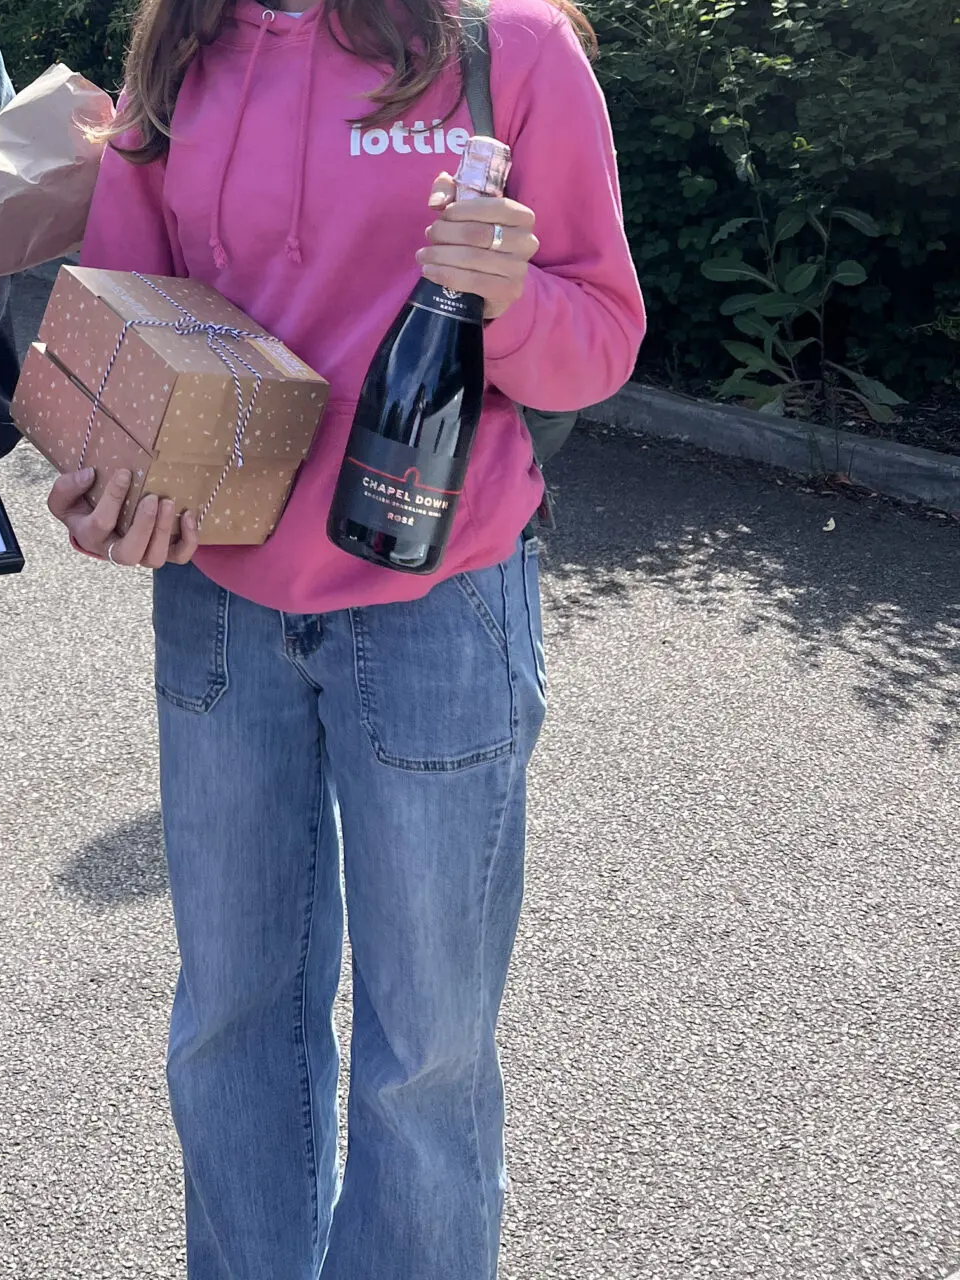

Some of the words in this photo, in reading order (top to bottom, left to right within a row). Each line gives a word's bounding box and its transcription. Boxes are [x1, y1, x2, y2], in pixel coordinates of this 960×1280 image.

[350, 119, 470, 156] lottie
[362, 476, 411, 502] CHAPEL
[414, 494, 449, 510] DOWN
[386, 512, 415, 527] ROSÉ
